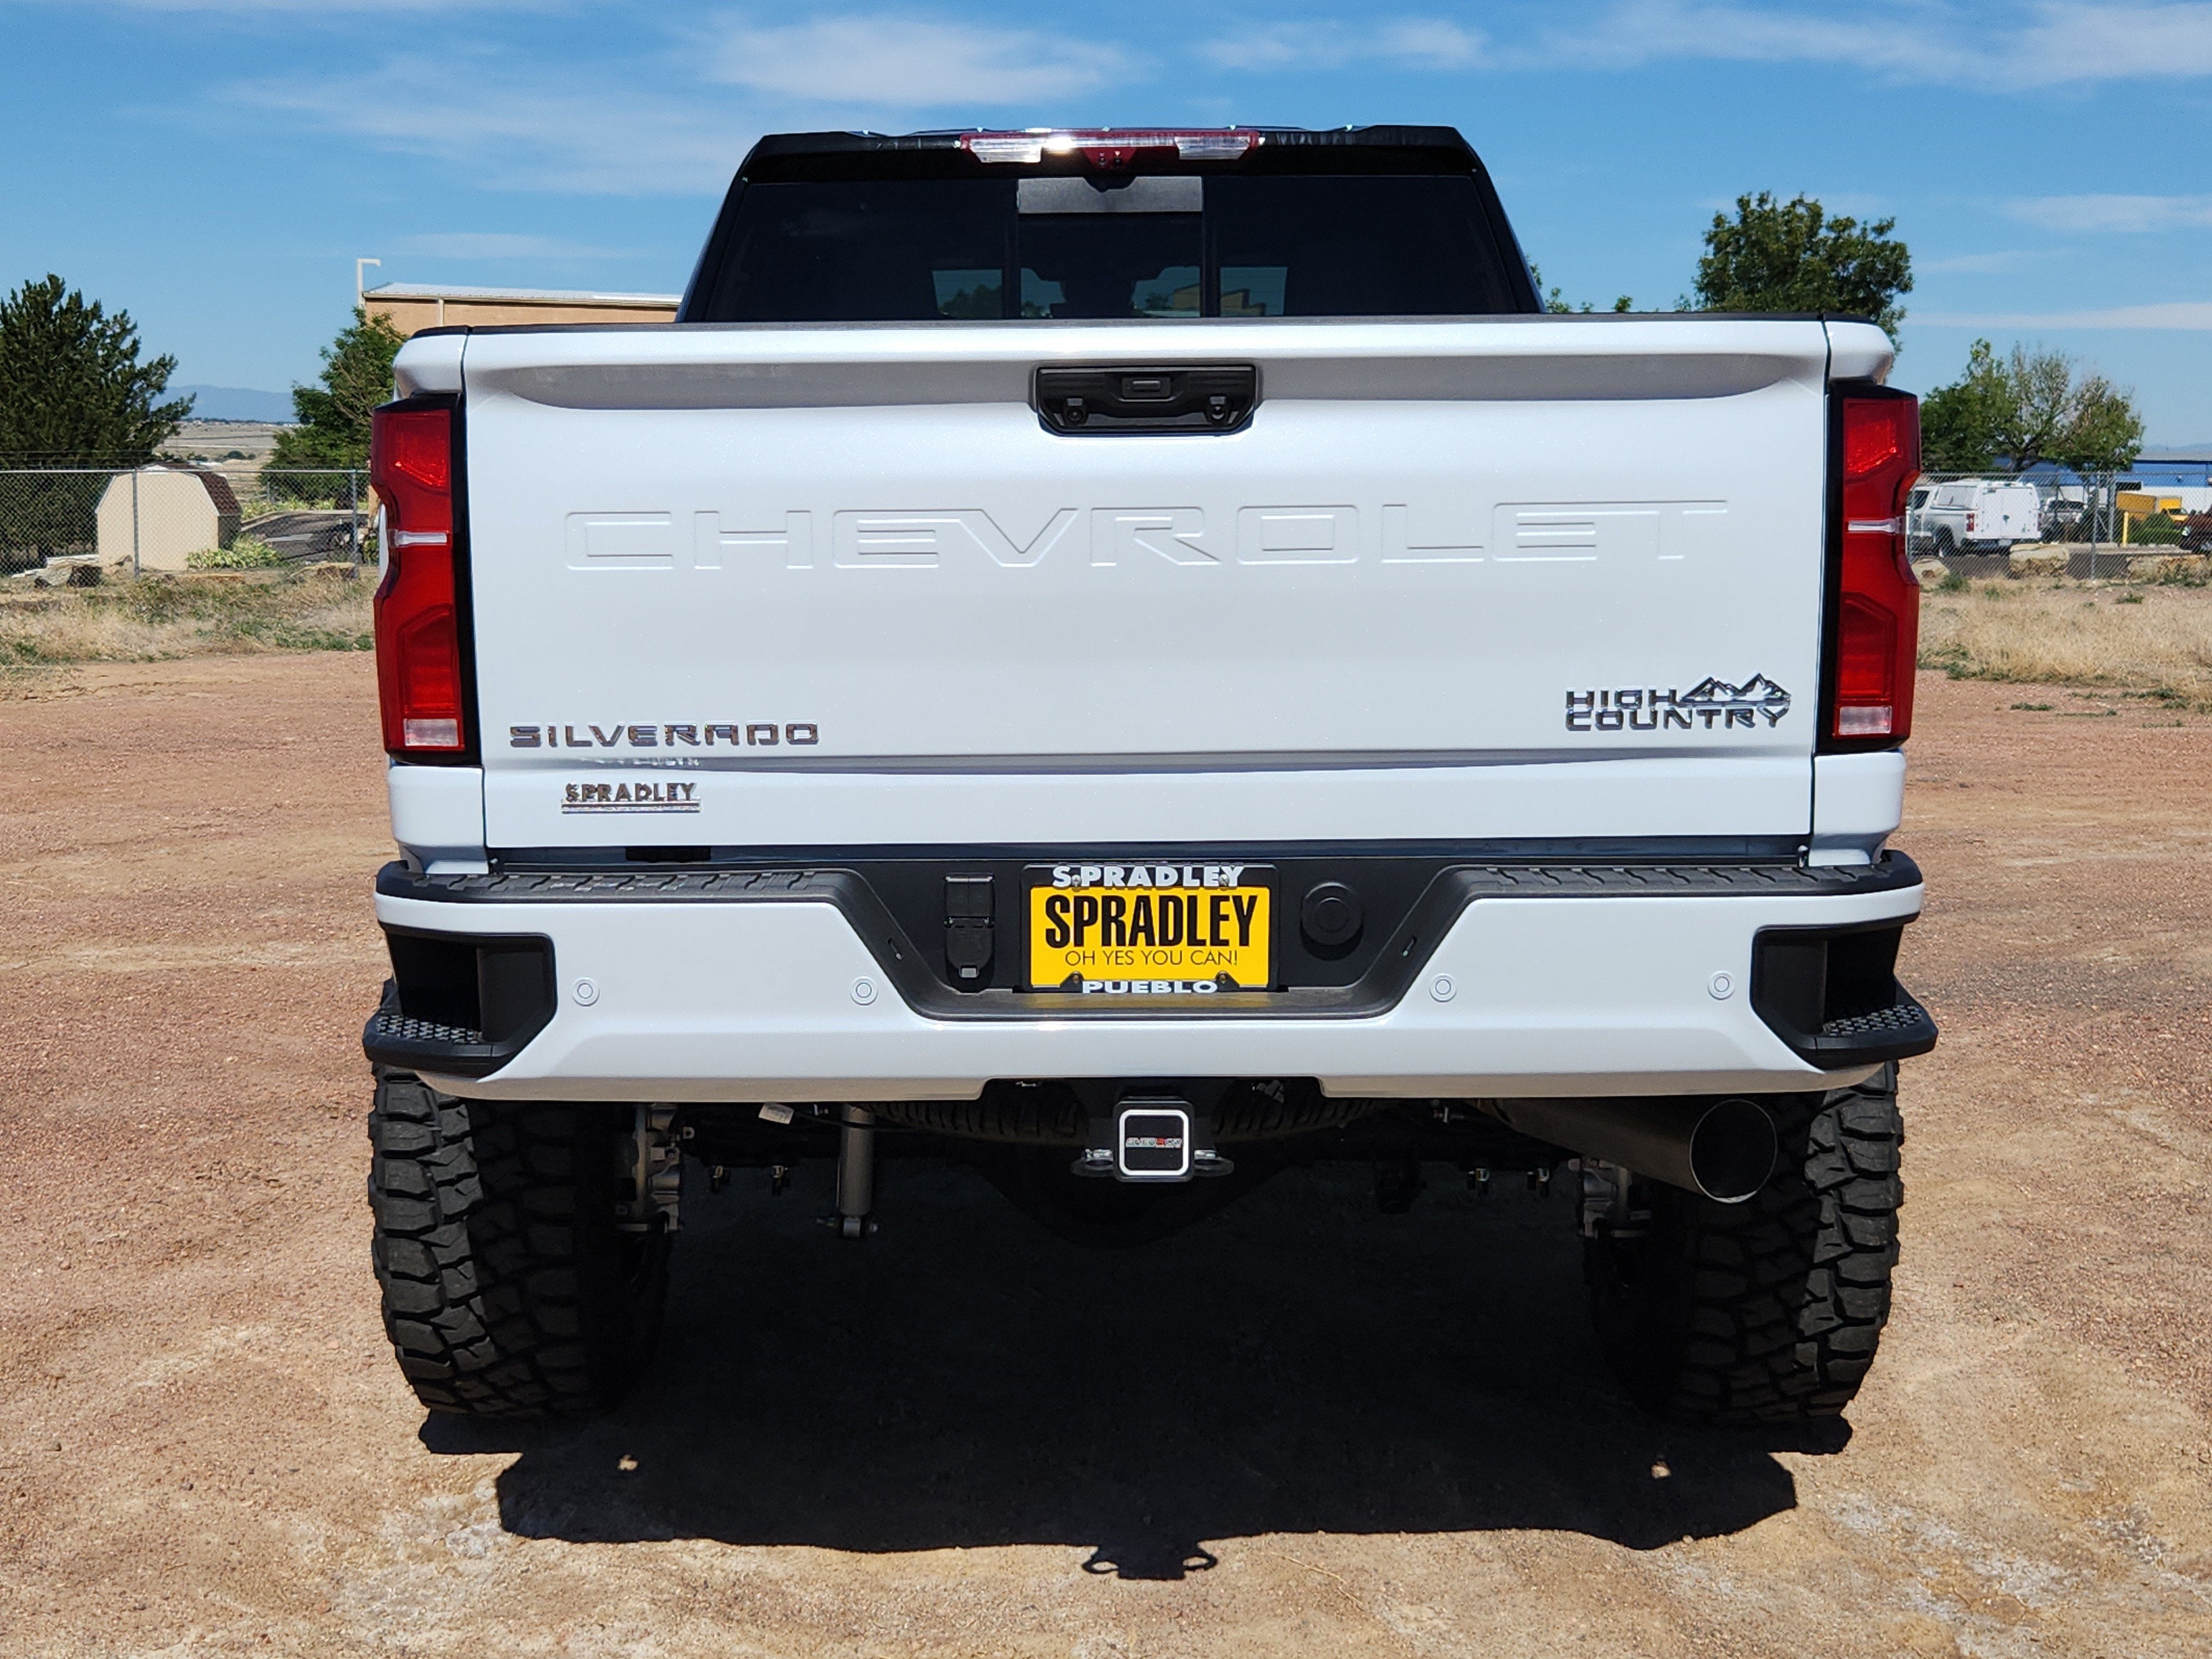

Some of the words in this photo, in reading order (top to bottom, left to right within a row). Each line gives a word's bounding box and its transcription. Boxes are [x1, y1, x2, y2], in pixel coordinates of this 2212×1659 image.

[564, 499, 1728, 571] CHEVROLET
[1565, 687, 1680, 709] HIGH
[1565, 707, 1791, 731] COUNTRY
[509, 722, 820, 747] SILVERADO
[564, 782, 697, 802] SPRADLEY
[1052, 865, 1245, 888] SPRADLEY
[1045, 895, 1258, 947] SPRADLEY
[1065, 950, 1095, 966] OH
[1102, 950, 1134, 966] YES
[1140, 950, 1183, 966] YOU
[1190, 950, 1238, 966] CAN!
[1082, 980, 1218, 994] PUEBLO
